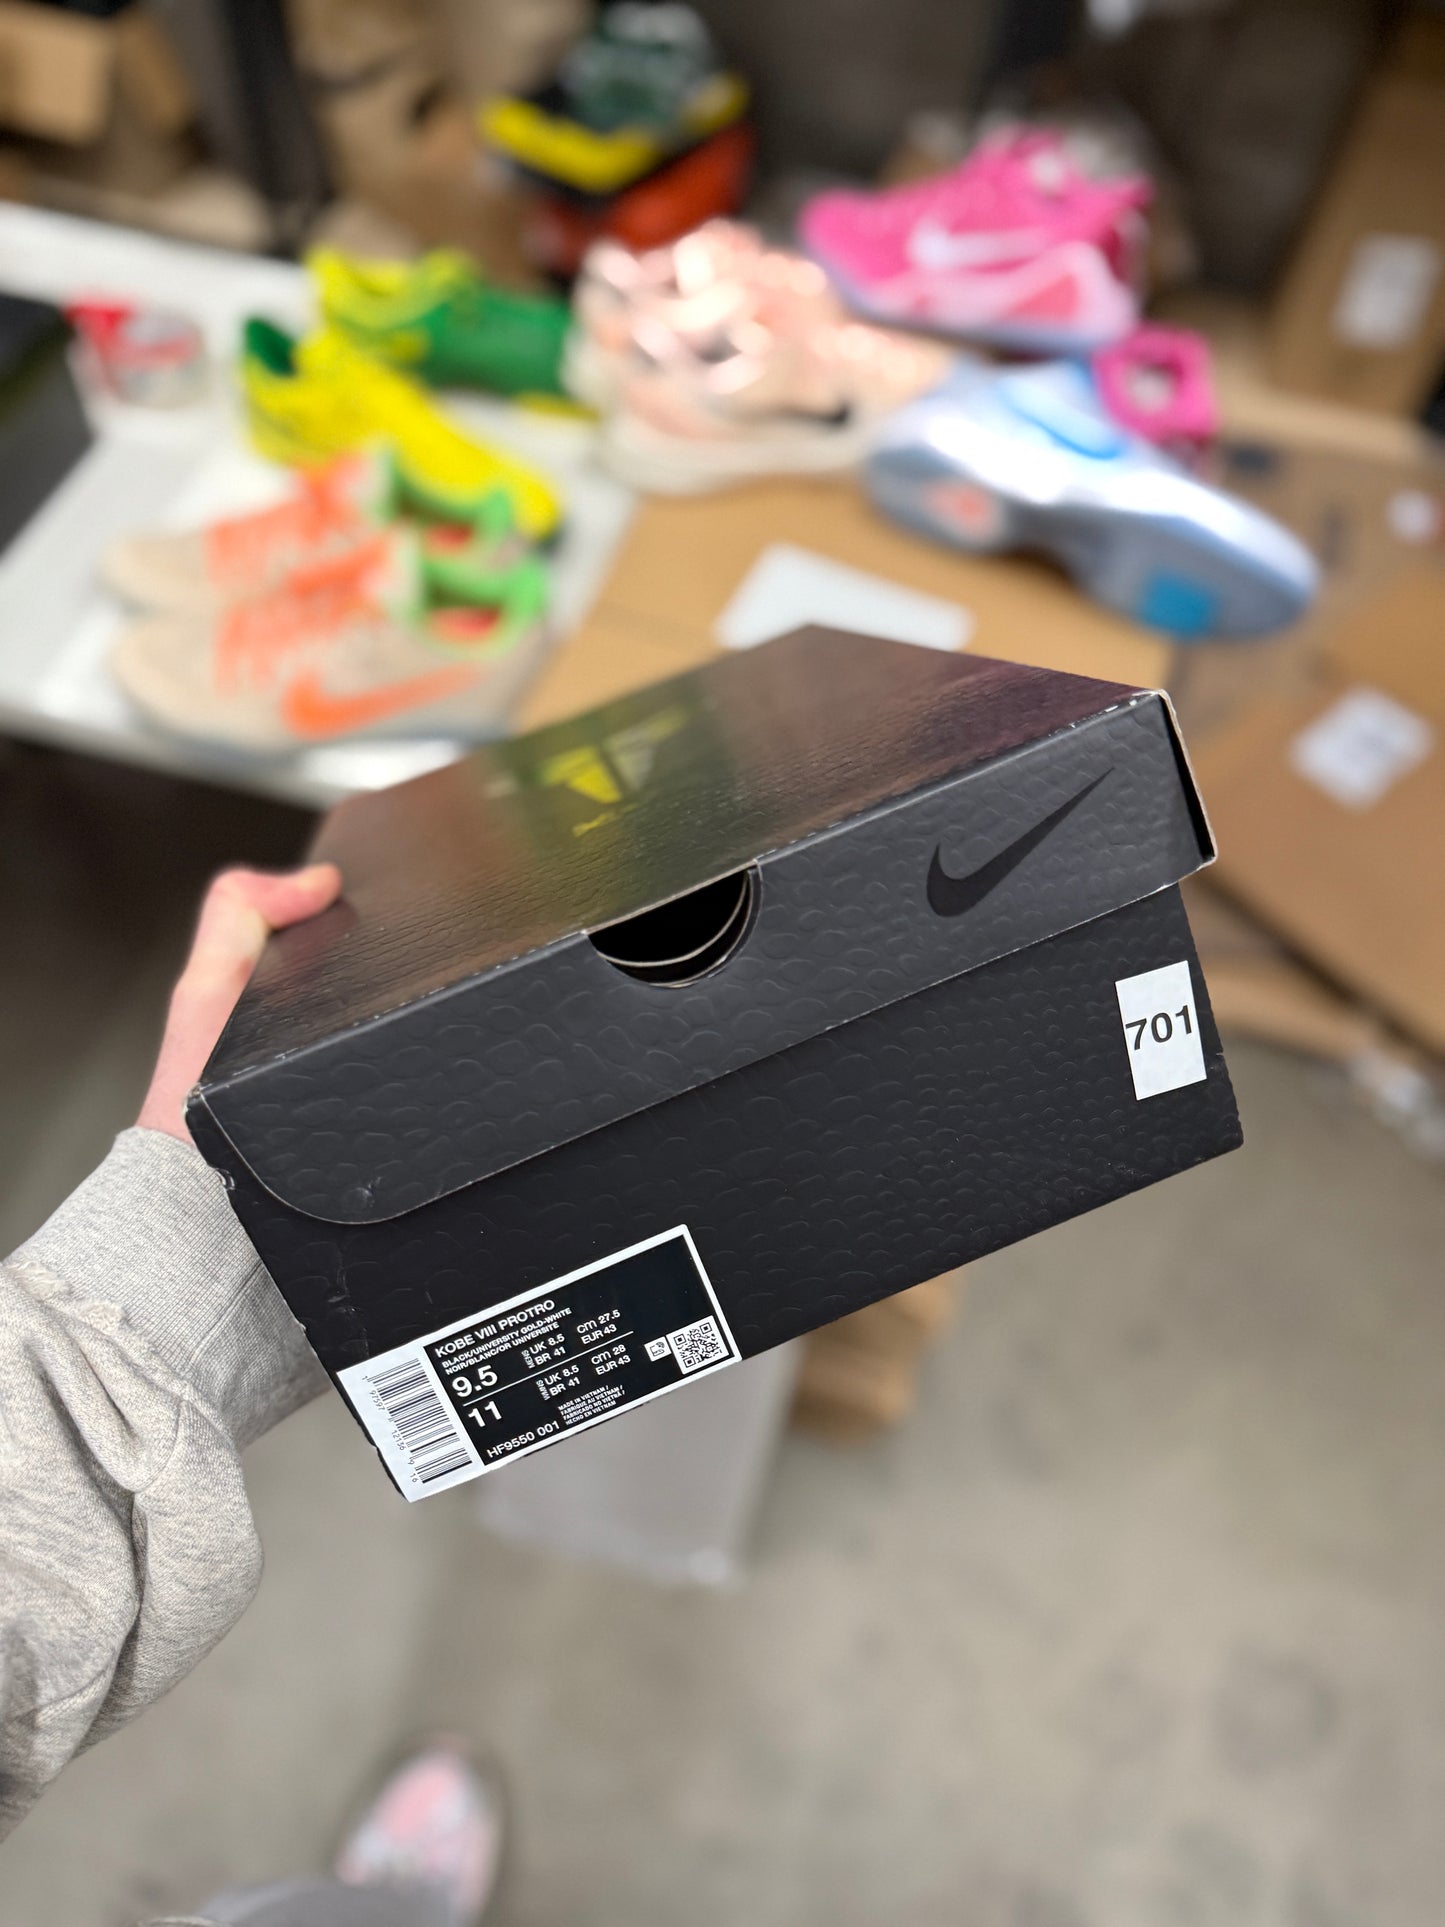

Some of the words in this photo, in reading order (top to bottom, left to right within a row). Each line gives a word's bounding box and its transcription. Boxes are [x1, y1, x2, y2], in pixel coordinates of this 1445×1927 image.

[1125, 1005, 1192, 1050] 701
[598, 1309, 621, 1325] 27.5
[435, 1334, 475, 1358] KOBE
[475, 1324, 497, 1340] VIII
[498, 1299, 555, 1331] PROTRO
[442, 1332, 520, 1369] BLACK/UNIVERSITY
[520, 1307, 572, 1334] GOLD-WHITE
[581, 1330, 604, 1345] EUR
[603, 1323, 617, 1335] 43
[445, 1342, 512, 1375] NOIR/BLANC/OR
[513, 1321, 560, 1346] UNIVERSITE
[529, 1342, 548, 1355] UK
[548, 1333, 565, 1346] 8.5
[612, 1344, 627, 1356] 28
[521, 1349, 535, 1369] MENS
[534, 1352, 551, 1366] BR
[554, 1346, 566, 1357] 41
[595, 1361, 617, 1376] EUR
[617, 1355, 631, 1366] 43
[452, 1364, 498, 1397] 9.5
[545, 1373, 562, 1386] UK
[562, 1364, 580, 1377] 8.5
[550, 1384, 567, 1397] BR
[568, 1377, 581, 1388] 41
[557, 1400, 574, 1411] MADE
[581, 1386, 605, 1400] VIETNAM
[560, 1400, 586, 1415] FABRIQUE
[595, 1386, 619, 1400] VIETNAM
[468, 1401, 502, 1428] 11
[562, 1403, 593, 1420] FABRICADO
[565, 1414, 583, 1425] HECHO
[592, 1399, 616, 1413] VIETNAM
[486, 1431, 535, 1459] HF9550
[537, 1420, 560, 1437] 001
[410, 1473, 418, 1483] 16
